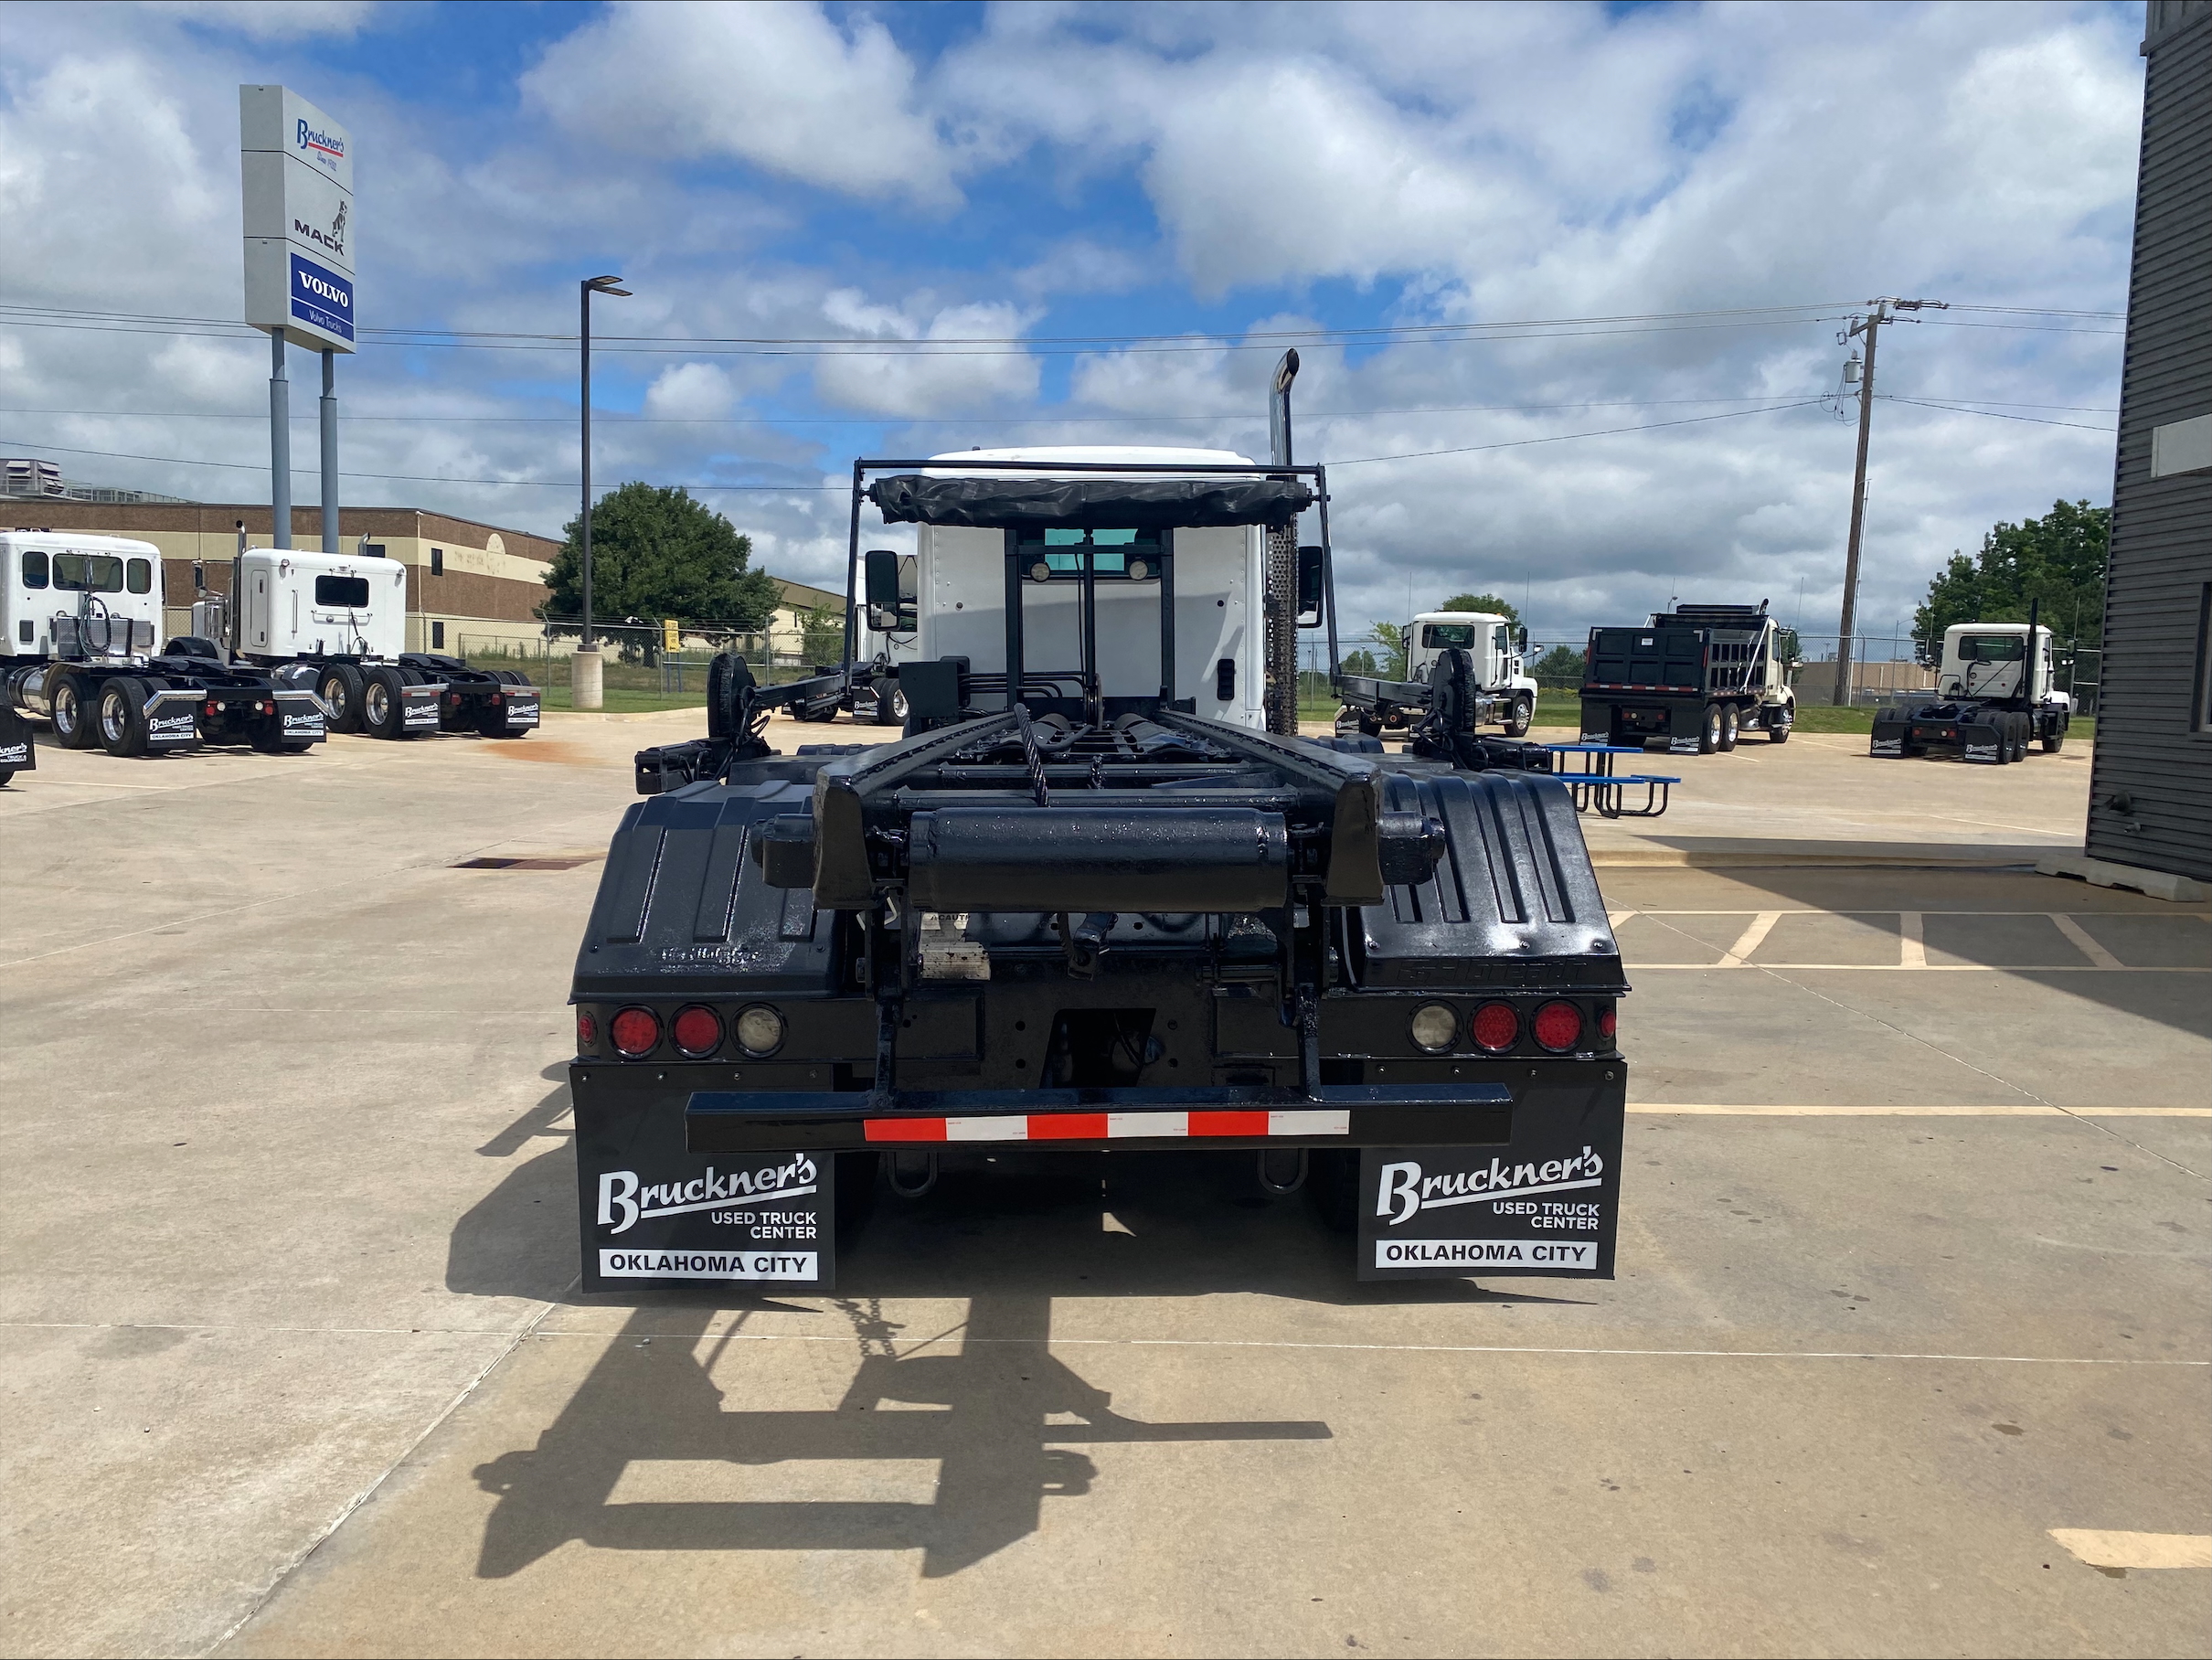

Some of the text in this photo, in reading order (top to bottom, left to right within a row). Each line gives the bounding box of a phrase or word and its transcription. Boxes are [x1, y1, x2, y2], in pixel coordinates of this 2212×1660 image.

[296, 118, 345, 153] Bruckner's
[294, 218, 345, 257] MACK
[298, 270, 349, 308] VOLVO
[308, 308, 343, 334] Volvo Trucks
[149, 714, 194, 732] Bruckner's
[282, 711, 324, 728] Bruckner's
[597, 1153, 817, 1234] Bruckner's
[1377, 1145, 1603, 1226] Bruckner's
[711, 1211, 817, 1225] USED TRUCK
[1493, 1202, 1601, 1217] USED TRUCK
[750, 1226, 817, 1239] CENTER
[1530, 1217, 1599, 1230] CENTER
[1386, 1244, 1587, 1261] OKLAHOMA CITY
[610, 1254, 807, 1273] OKLAHOMA CITY
